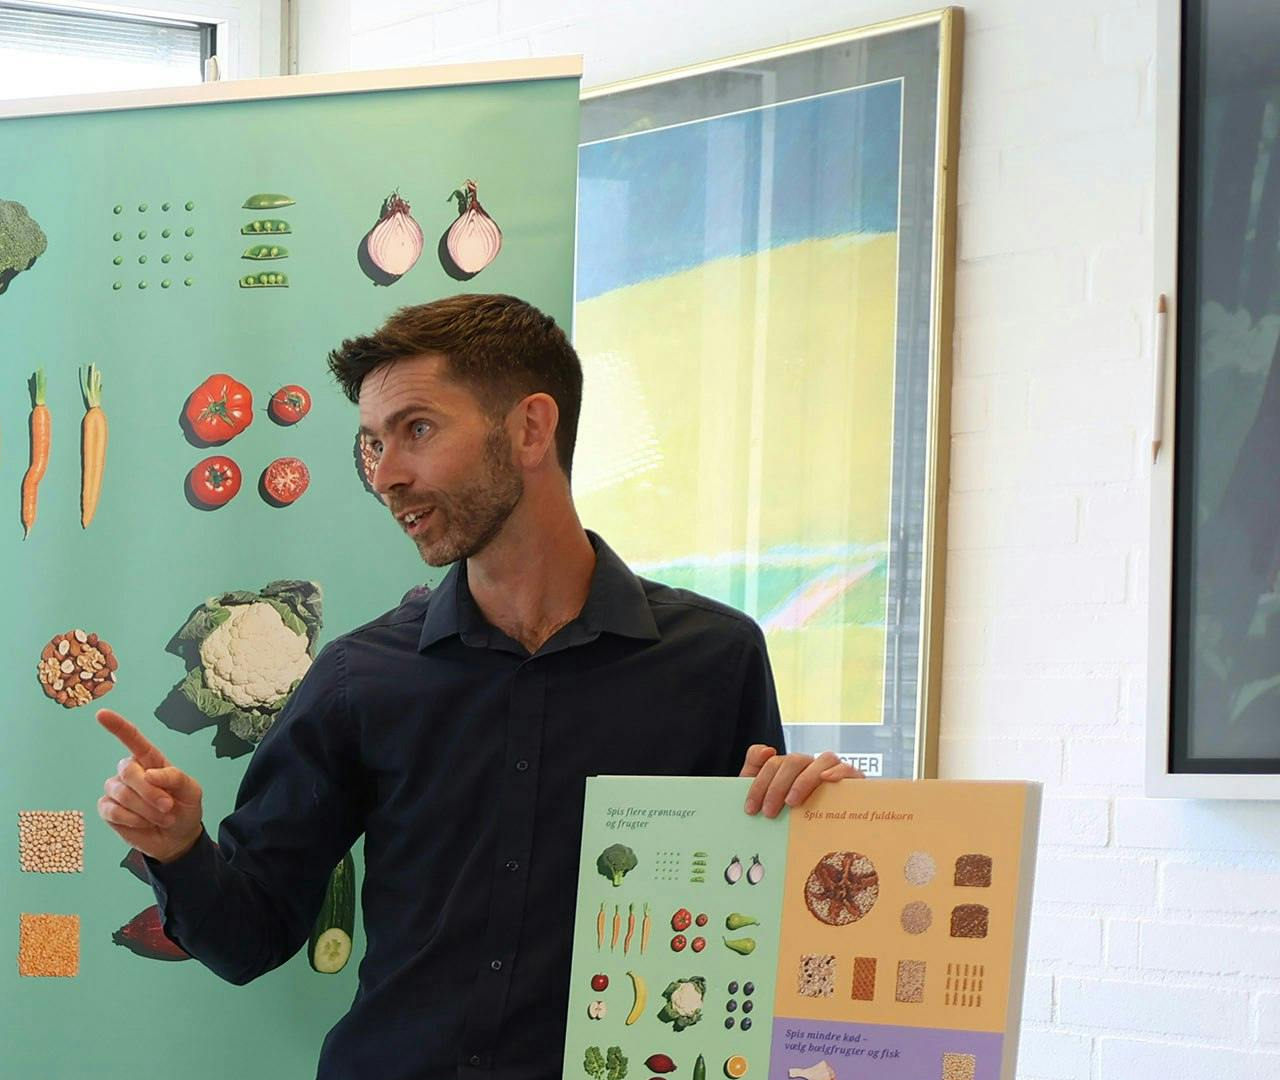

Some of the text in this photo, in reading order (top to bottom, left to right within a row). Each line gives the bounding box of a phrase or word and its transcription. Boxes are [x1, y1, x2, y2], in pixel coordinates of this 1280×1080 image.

[607, 807, 696, 819] Spis flere grøntsager
[804, 810, 914, 822] Spis mad med fuldkorn
[606, 819, 649, 830] og frugter
[785, 1029, 804, 1040] Spis
[807, 1030, 841, 1041] mindre
[843, 1033, 861, 1042] kød
[784, 1042, 901, 1059] vælg bælgfrugter og fisk
